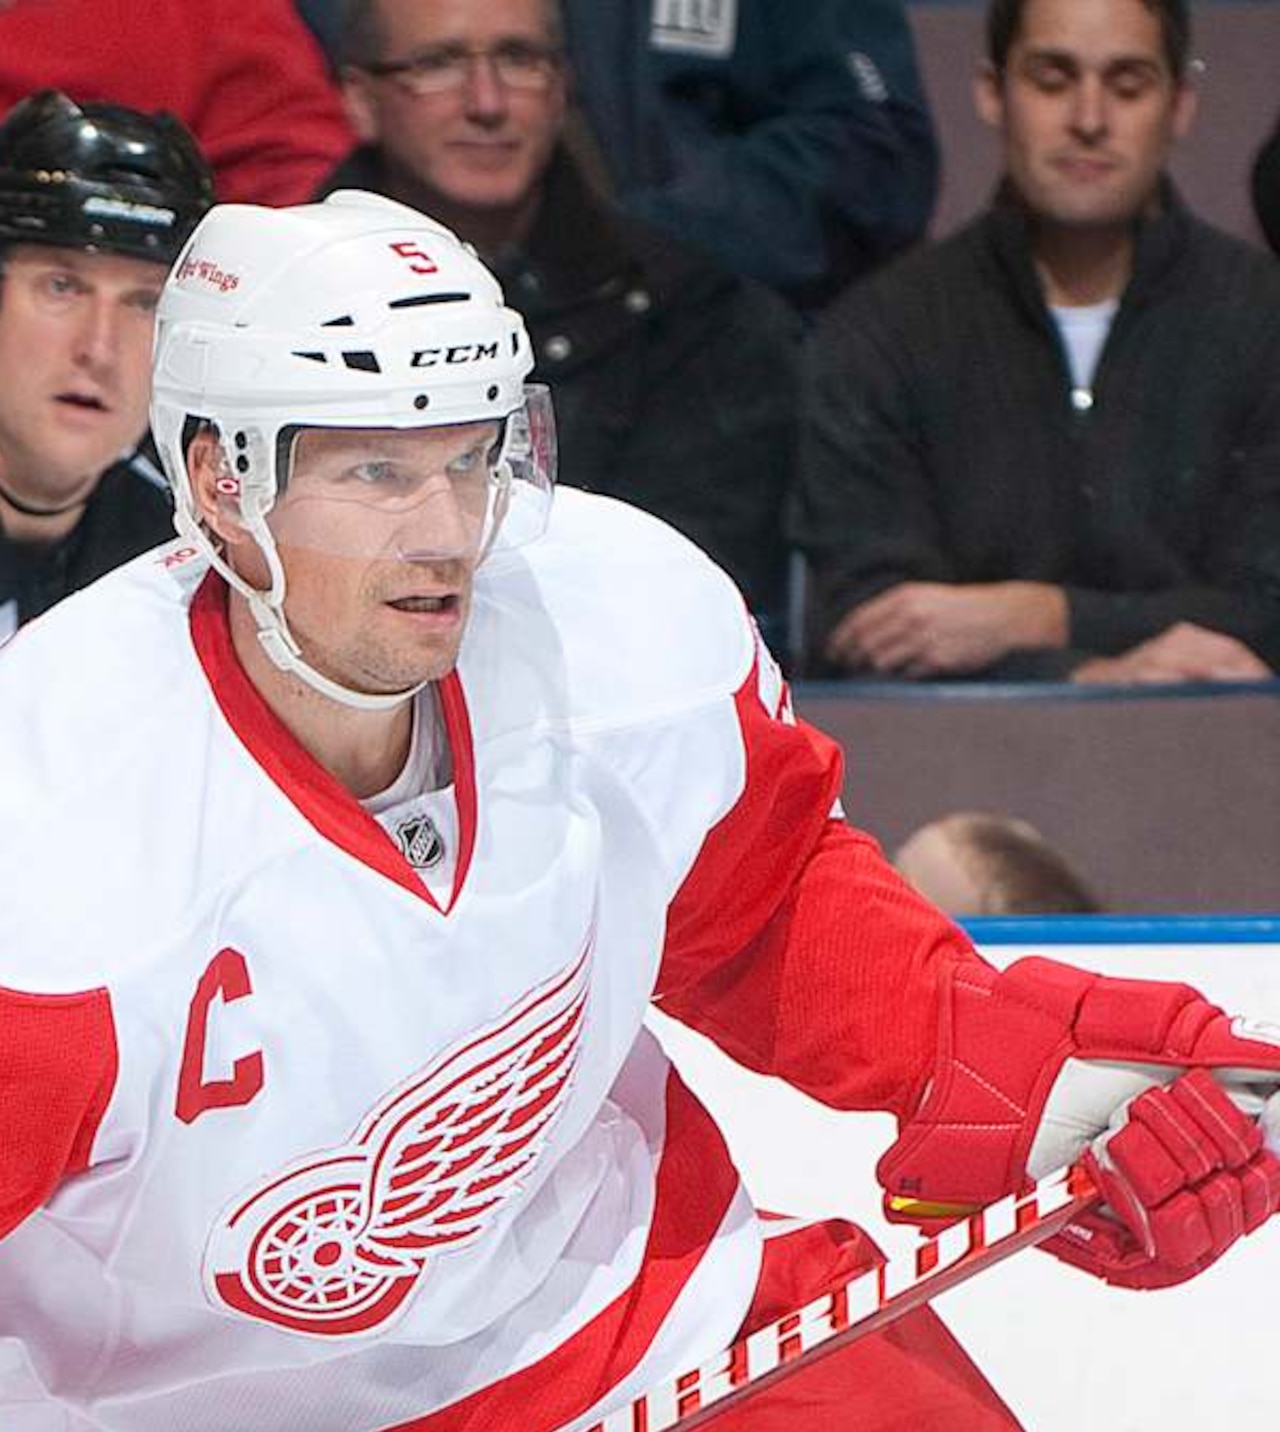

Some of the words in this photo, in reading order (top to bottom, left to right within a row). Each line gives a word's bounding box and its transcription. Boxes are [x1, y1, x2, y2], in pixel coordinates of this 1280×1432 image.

[389, 242, 438, 275] 5
[409, 341, 499, 368] CCM
[175, 946, 265, 1125] C
